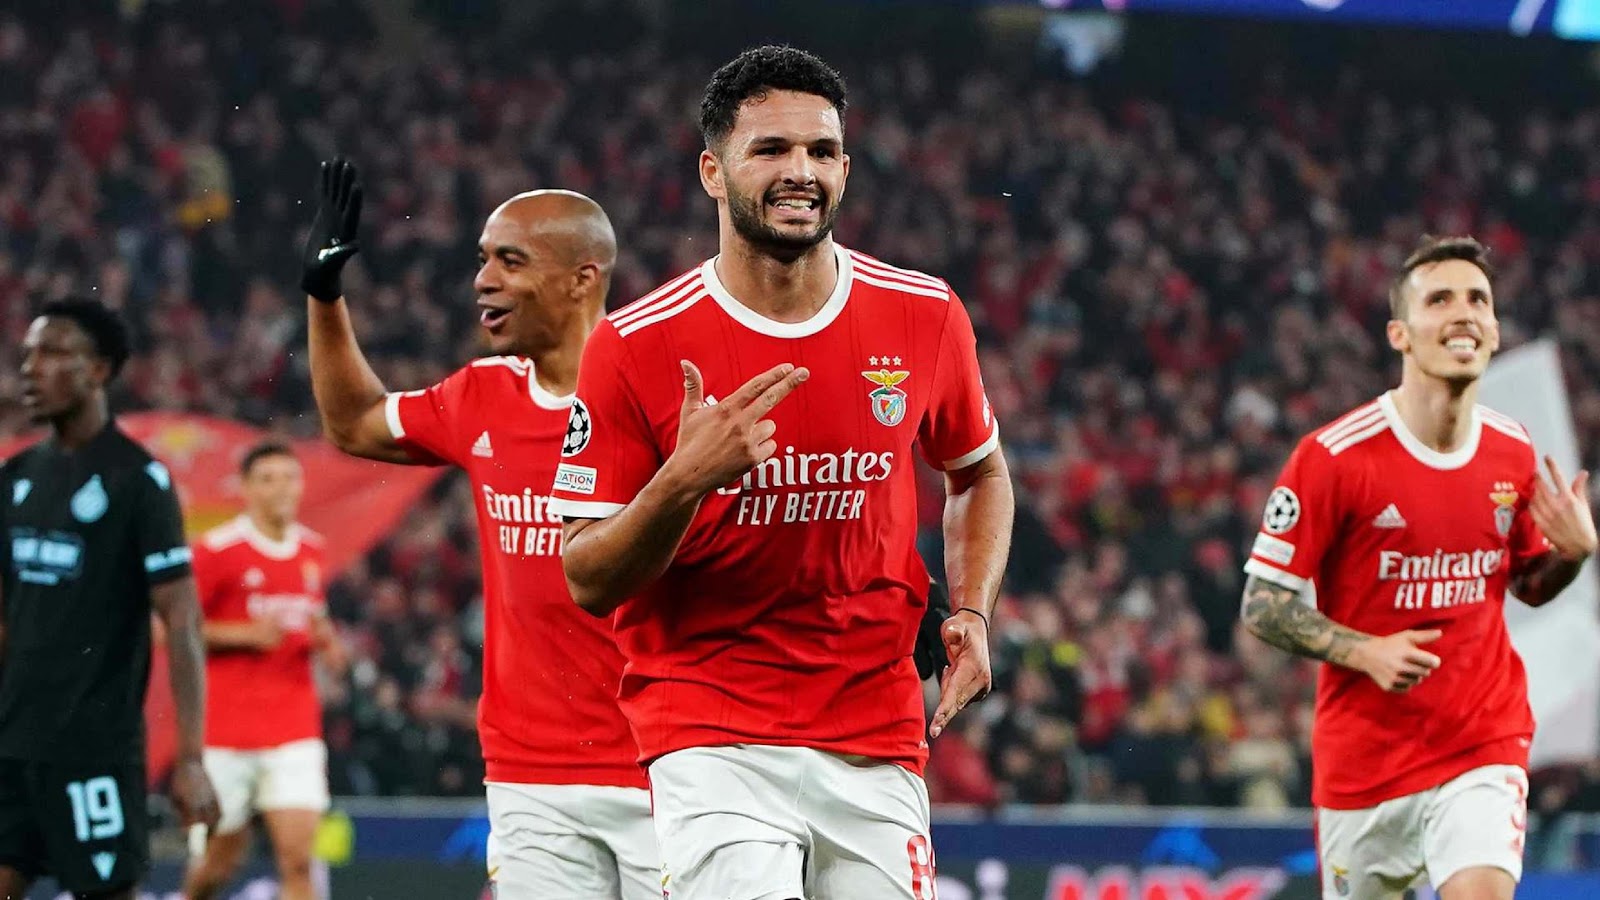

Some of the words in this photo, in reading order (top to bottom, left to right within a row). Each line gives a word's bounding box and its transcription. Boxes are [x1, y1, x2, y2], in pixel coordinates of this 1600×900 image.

[717, 446, 893, 495] mirates
[737, 495, 778, 526] FLY
[783, 490, 866, 523] BETTER
[500, 525, 521, 554] FLY
[1395, 582, 1427, 609] FLY
[66, 776, 125, 841] 19
[907, 834, 937, 900] 8
